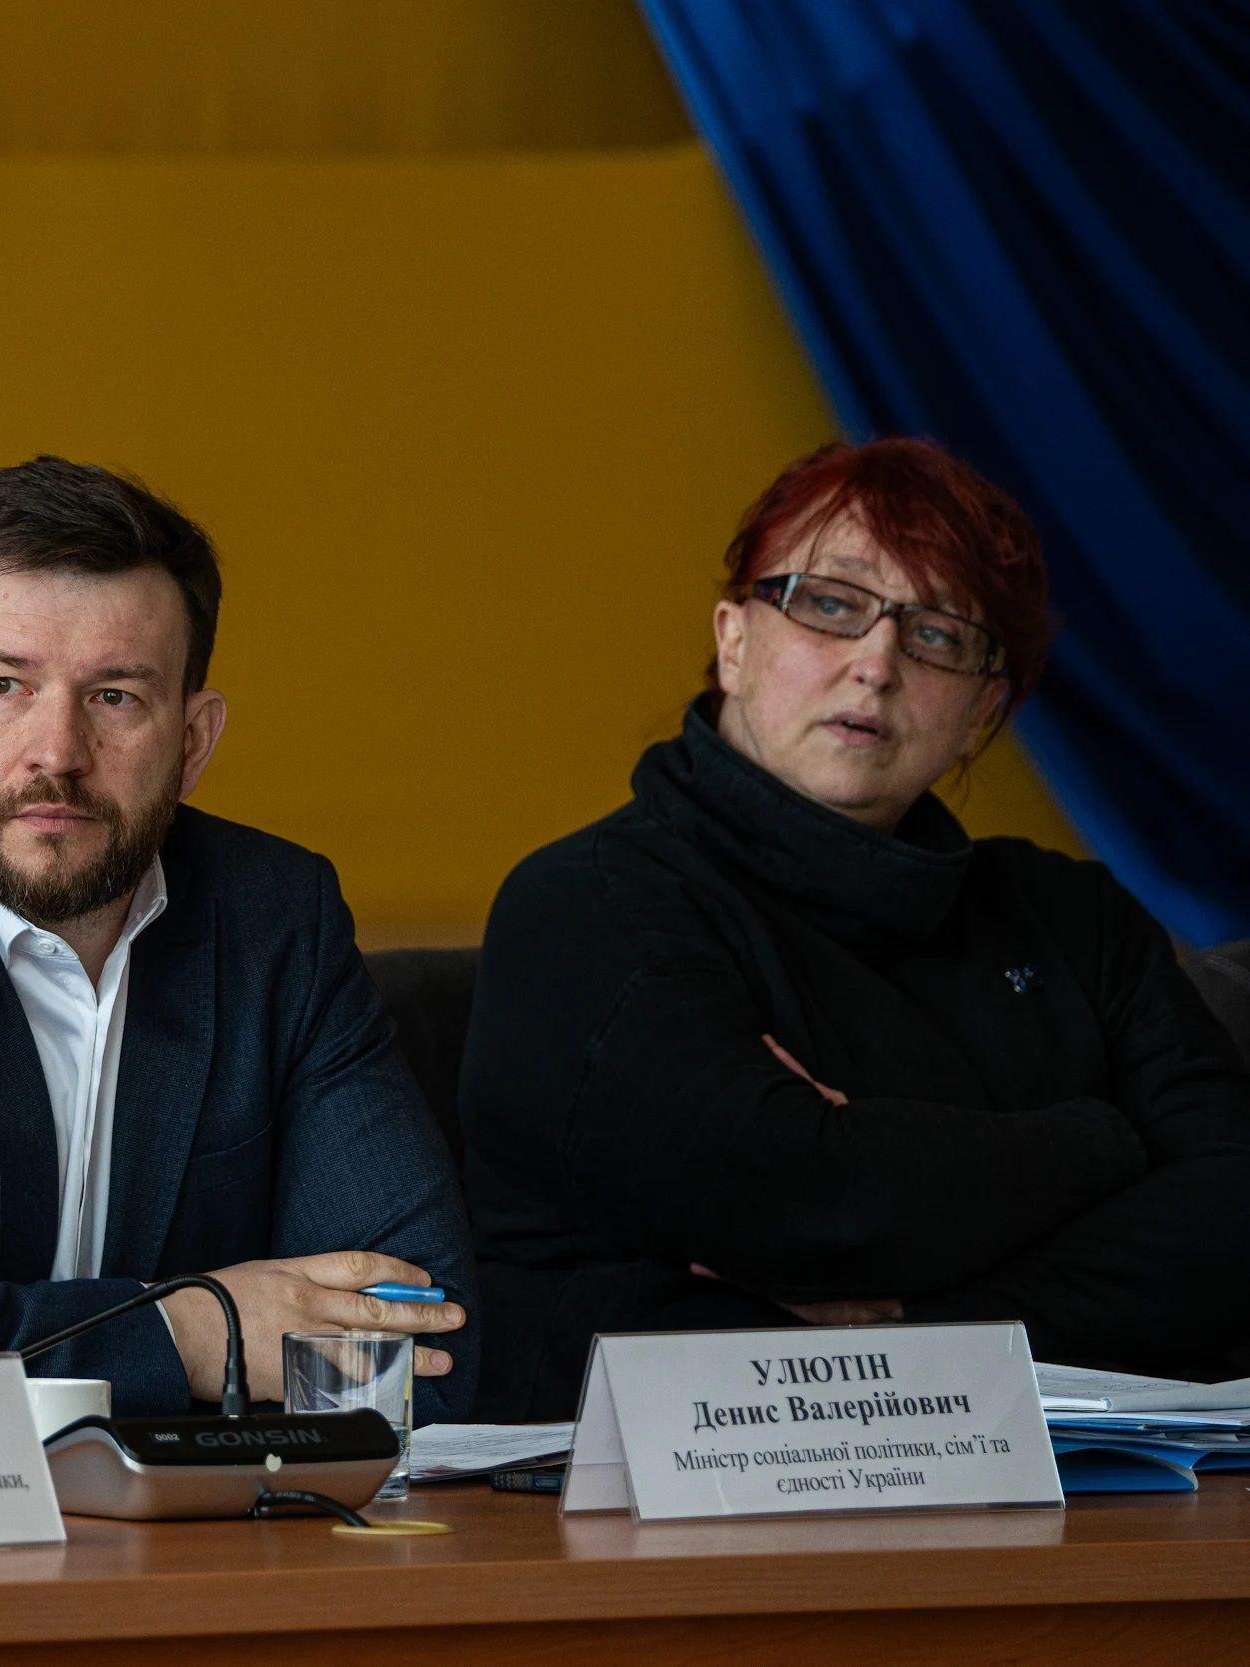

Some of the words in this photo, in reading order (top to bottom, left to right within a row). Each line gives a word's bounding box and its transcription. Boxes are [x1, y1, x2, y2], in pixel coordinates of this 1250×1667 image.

[749, 1353, 894, 1386] УЛЮТІН
[692, 1401, 780, 1434] Денис
[785, 1391, 972, 1426] Валерійович
[155, 1432, 180, 1442] 0002
[195, 1428, 321, 1447] GONSIN
[673, 1448, 749, 1473] Міністр
[753, 1441, 851, 1467] соціальної
[854, 1438, 943, 1461] політики,
[990, 1438, 1011, 1453] та
[776, 1469, 846, 1495] єдності
[848, 1467, 926, 1493] України
